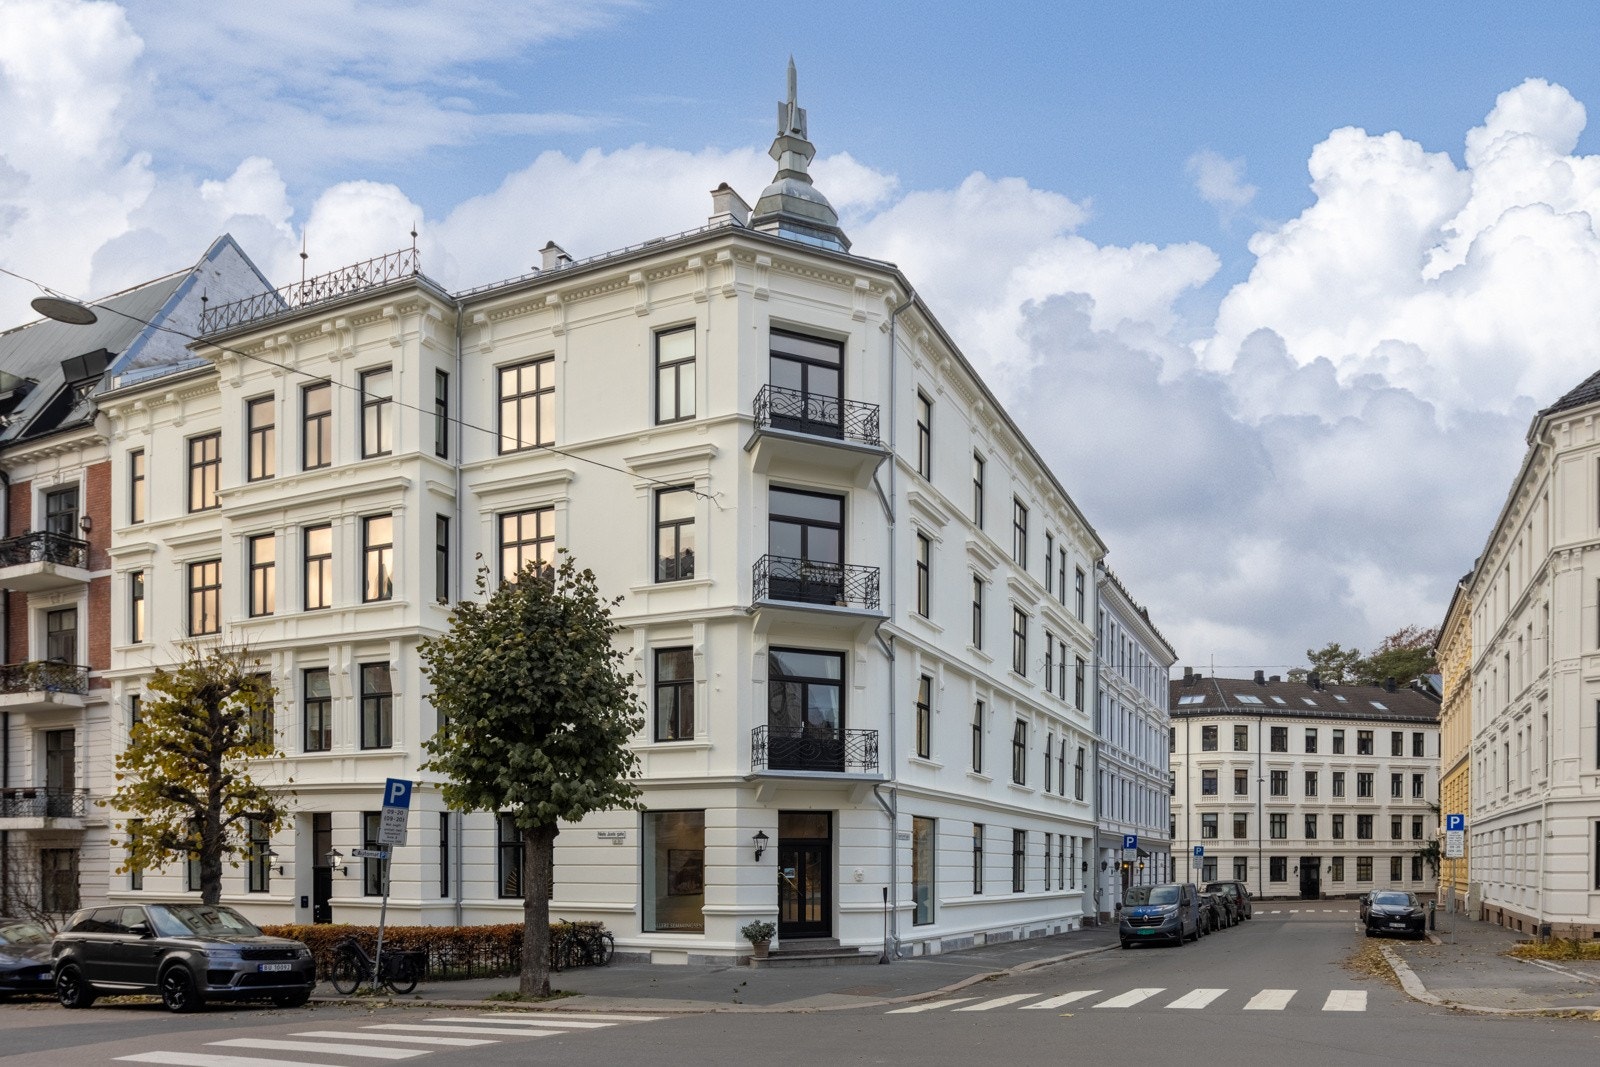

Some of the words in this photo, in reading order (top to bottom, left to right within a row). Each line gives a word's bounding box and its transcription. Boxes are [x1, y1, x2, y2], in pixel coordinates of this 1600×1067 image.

[389, 782, 406, 804] P
[386, 808, 404, 816] 09-20
[1450, 816, 1460, 829] P
[1126, 836, 1135, 848] P
